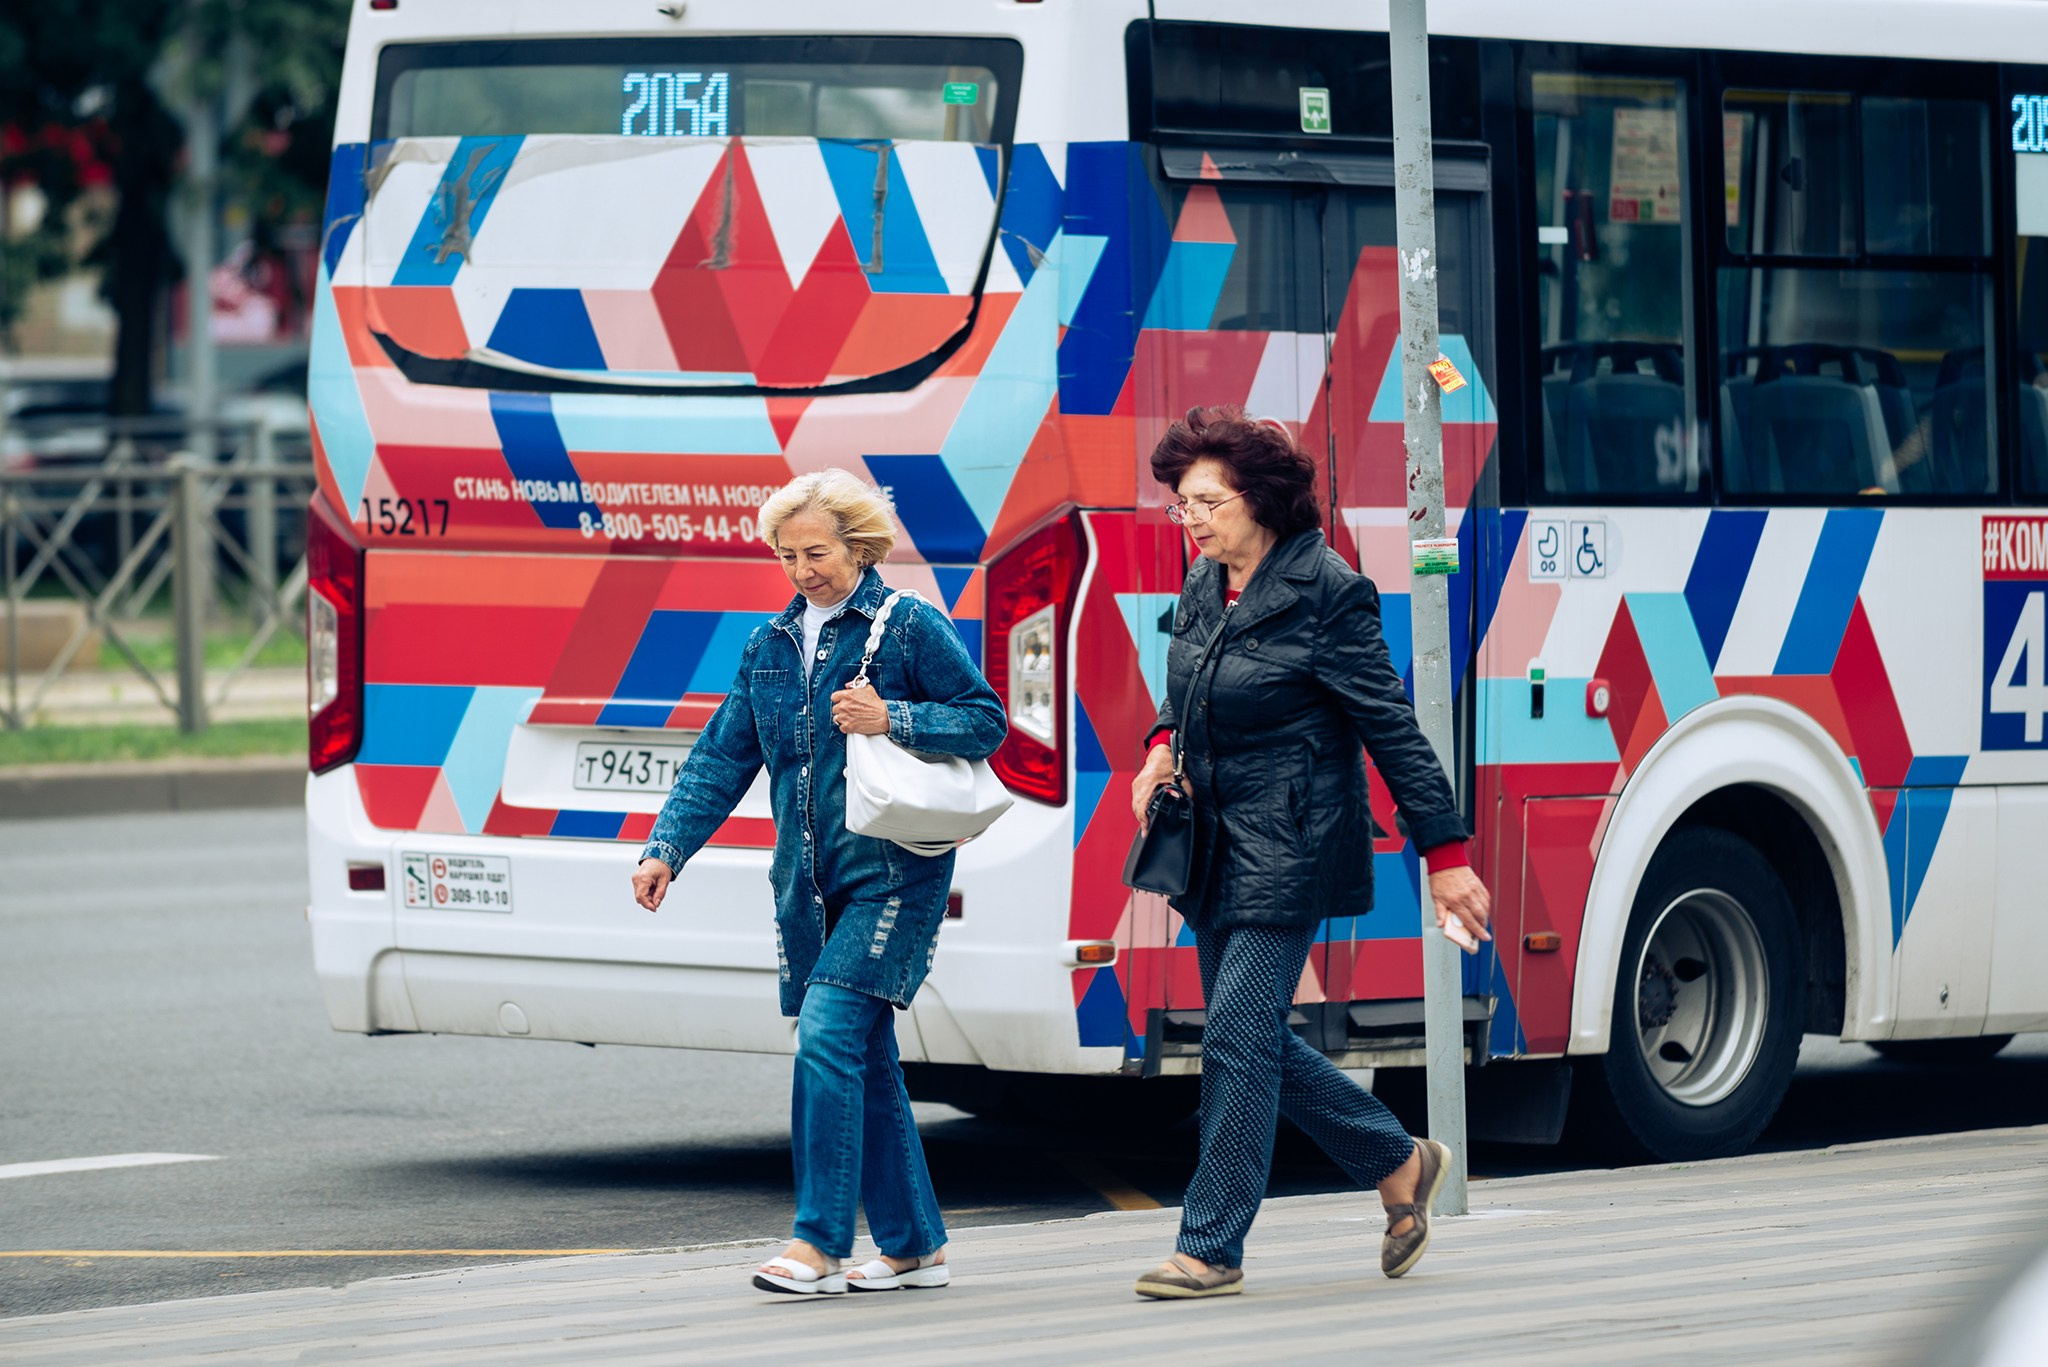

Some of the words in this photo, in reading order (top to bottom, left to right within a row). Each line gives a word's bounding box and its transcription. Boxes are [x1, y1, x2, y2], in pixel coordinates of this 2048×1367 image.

[453, 477, 509, 501] СТАНЬ
[511, 479, 579, 503] НОВЫМ
[580, 481, 691, 507] ВОДИТЕЛЕМ
[692, 484, 721, 507] НА
[723, 484, 780, 508] НОВО
[362, 498, 450, 537] 15217
[451, 888, 508, 905] 309-10-10
